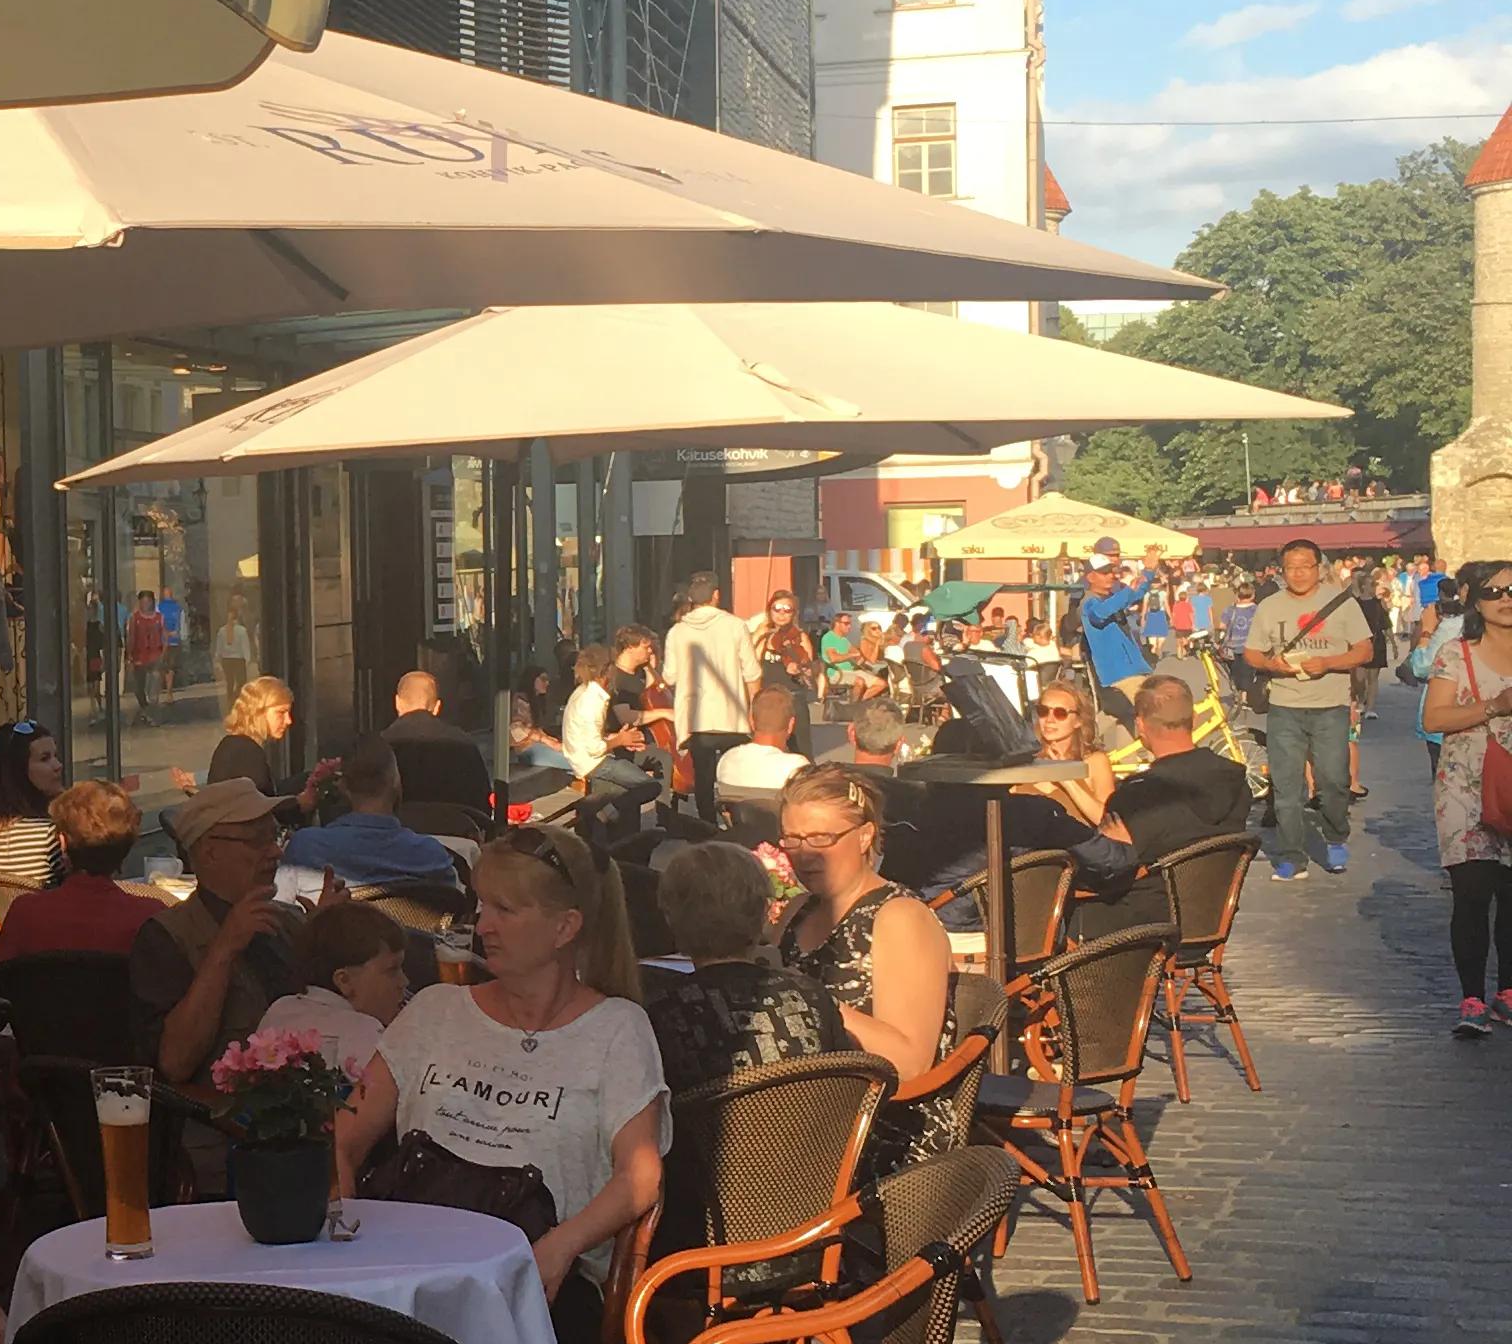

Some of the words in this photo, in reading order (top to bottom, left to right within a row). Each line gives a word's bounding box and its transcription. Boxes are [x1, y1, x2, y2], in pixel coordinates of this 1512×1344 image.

[961, 544, 985, 555] saku
[1021, 544, 1045, 555] saku
[1082, 544, 1097, 555] sa
